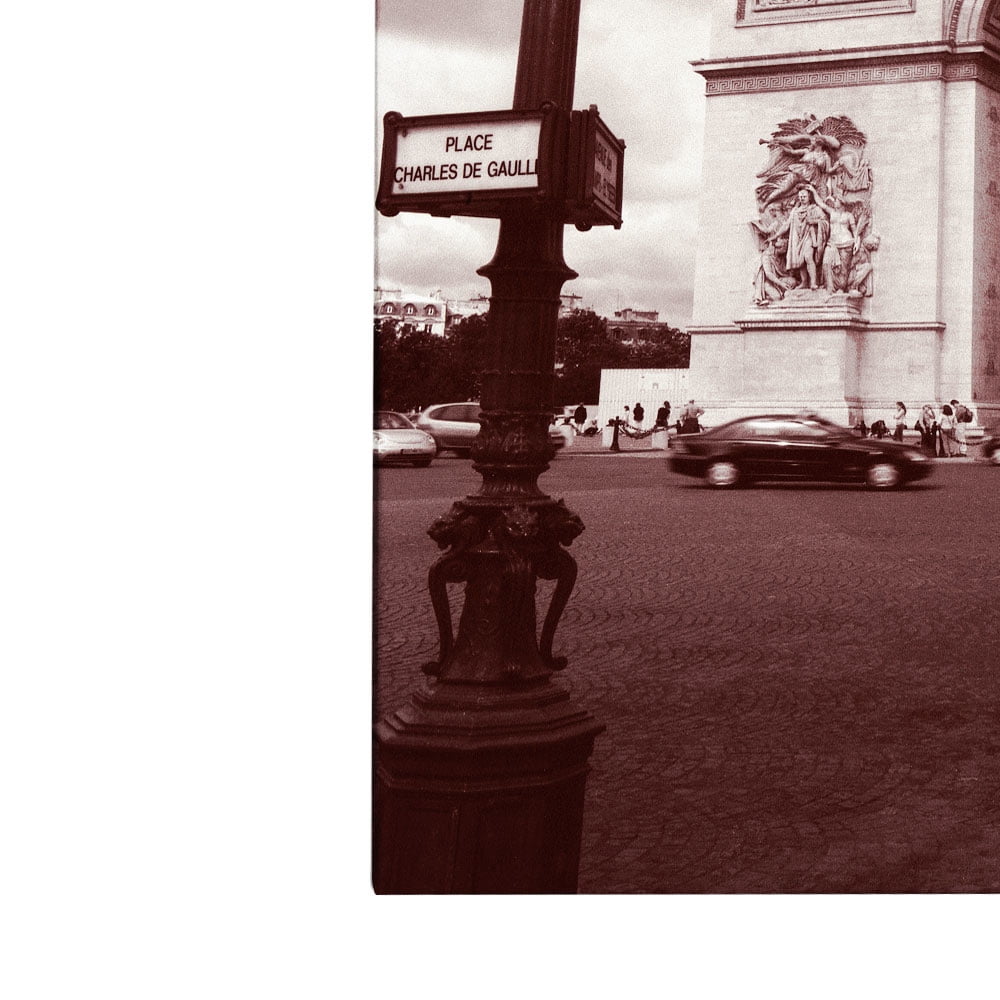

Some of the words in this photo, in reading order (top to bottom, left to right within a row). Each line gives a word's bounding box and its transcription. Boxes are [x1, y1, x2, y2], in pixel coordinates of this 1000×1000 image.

[445, 134, 493, 153] PLACE
[394, 163, 458, 183] CHARLES
[462, 162, 482, 179] DE
